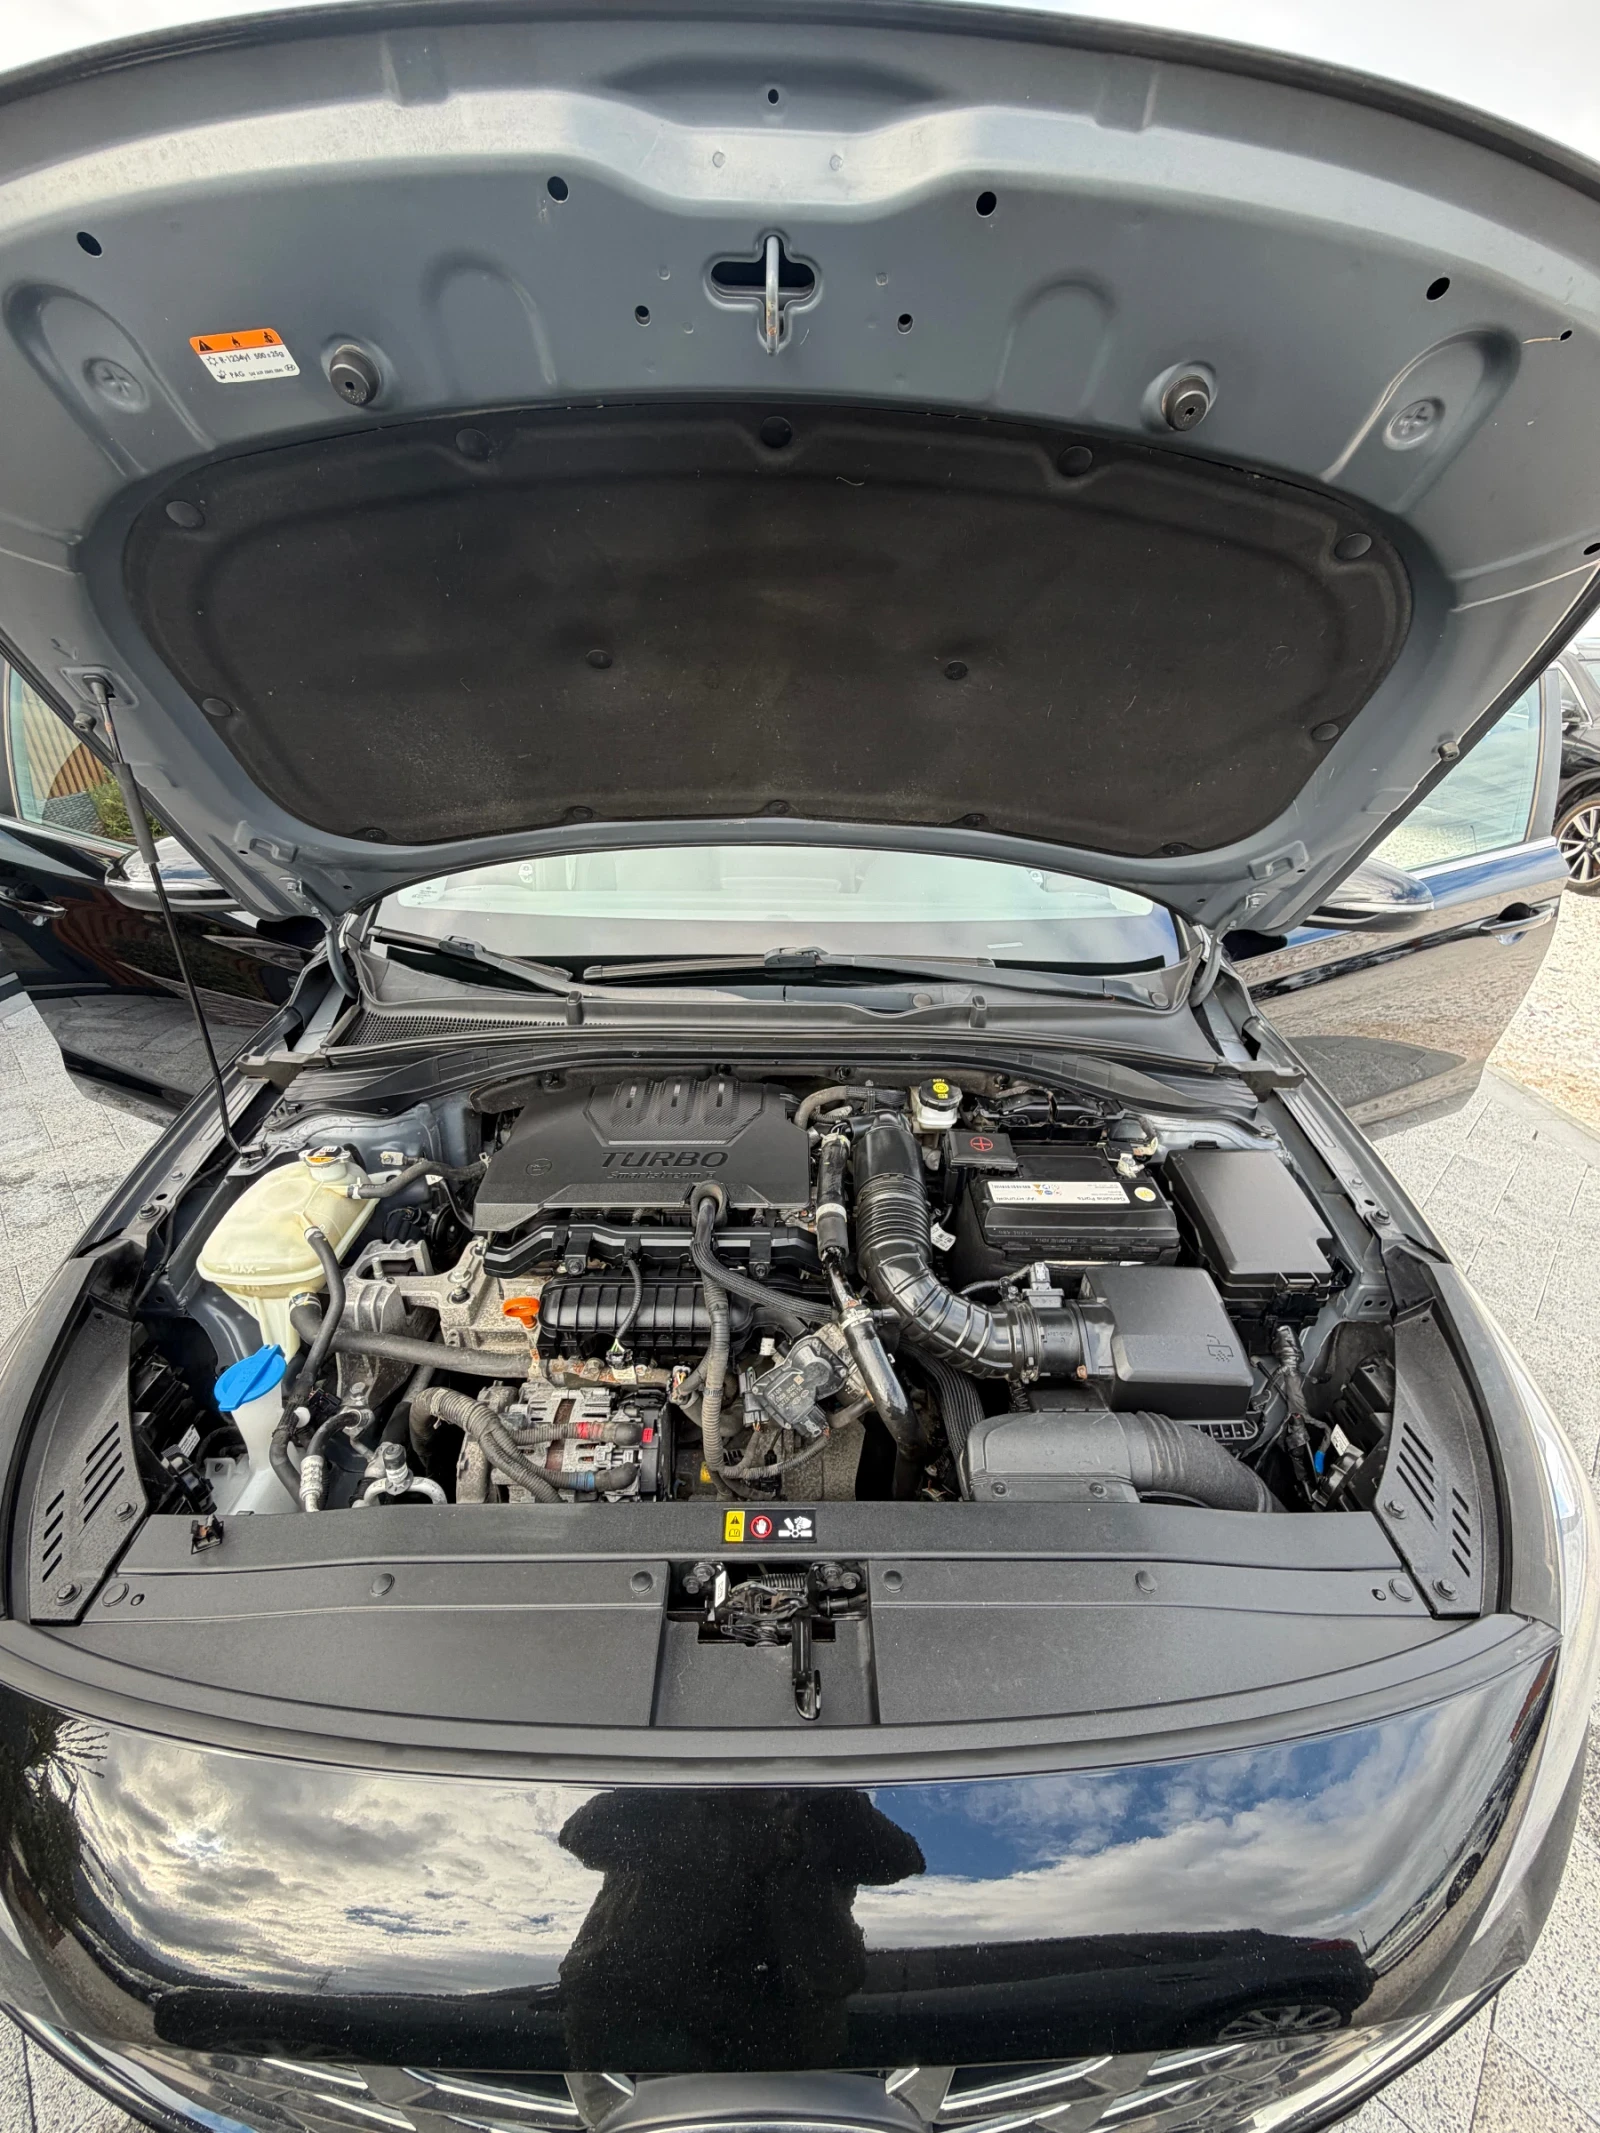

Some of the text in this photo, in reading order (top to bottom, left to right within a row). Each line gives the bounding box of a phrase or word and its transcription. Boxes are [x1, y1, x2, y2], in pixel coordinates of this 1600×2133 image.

[229, 370, 245, 379] PAG
[601, 1151, 729, 1168] TURBO
[607, 1170, 701, 1179] Smartstream
[229, 1263, 255, 1274] MAX
